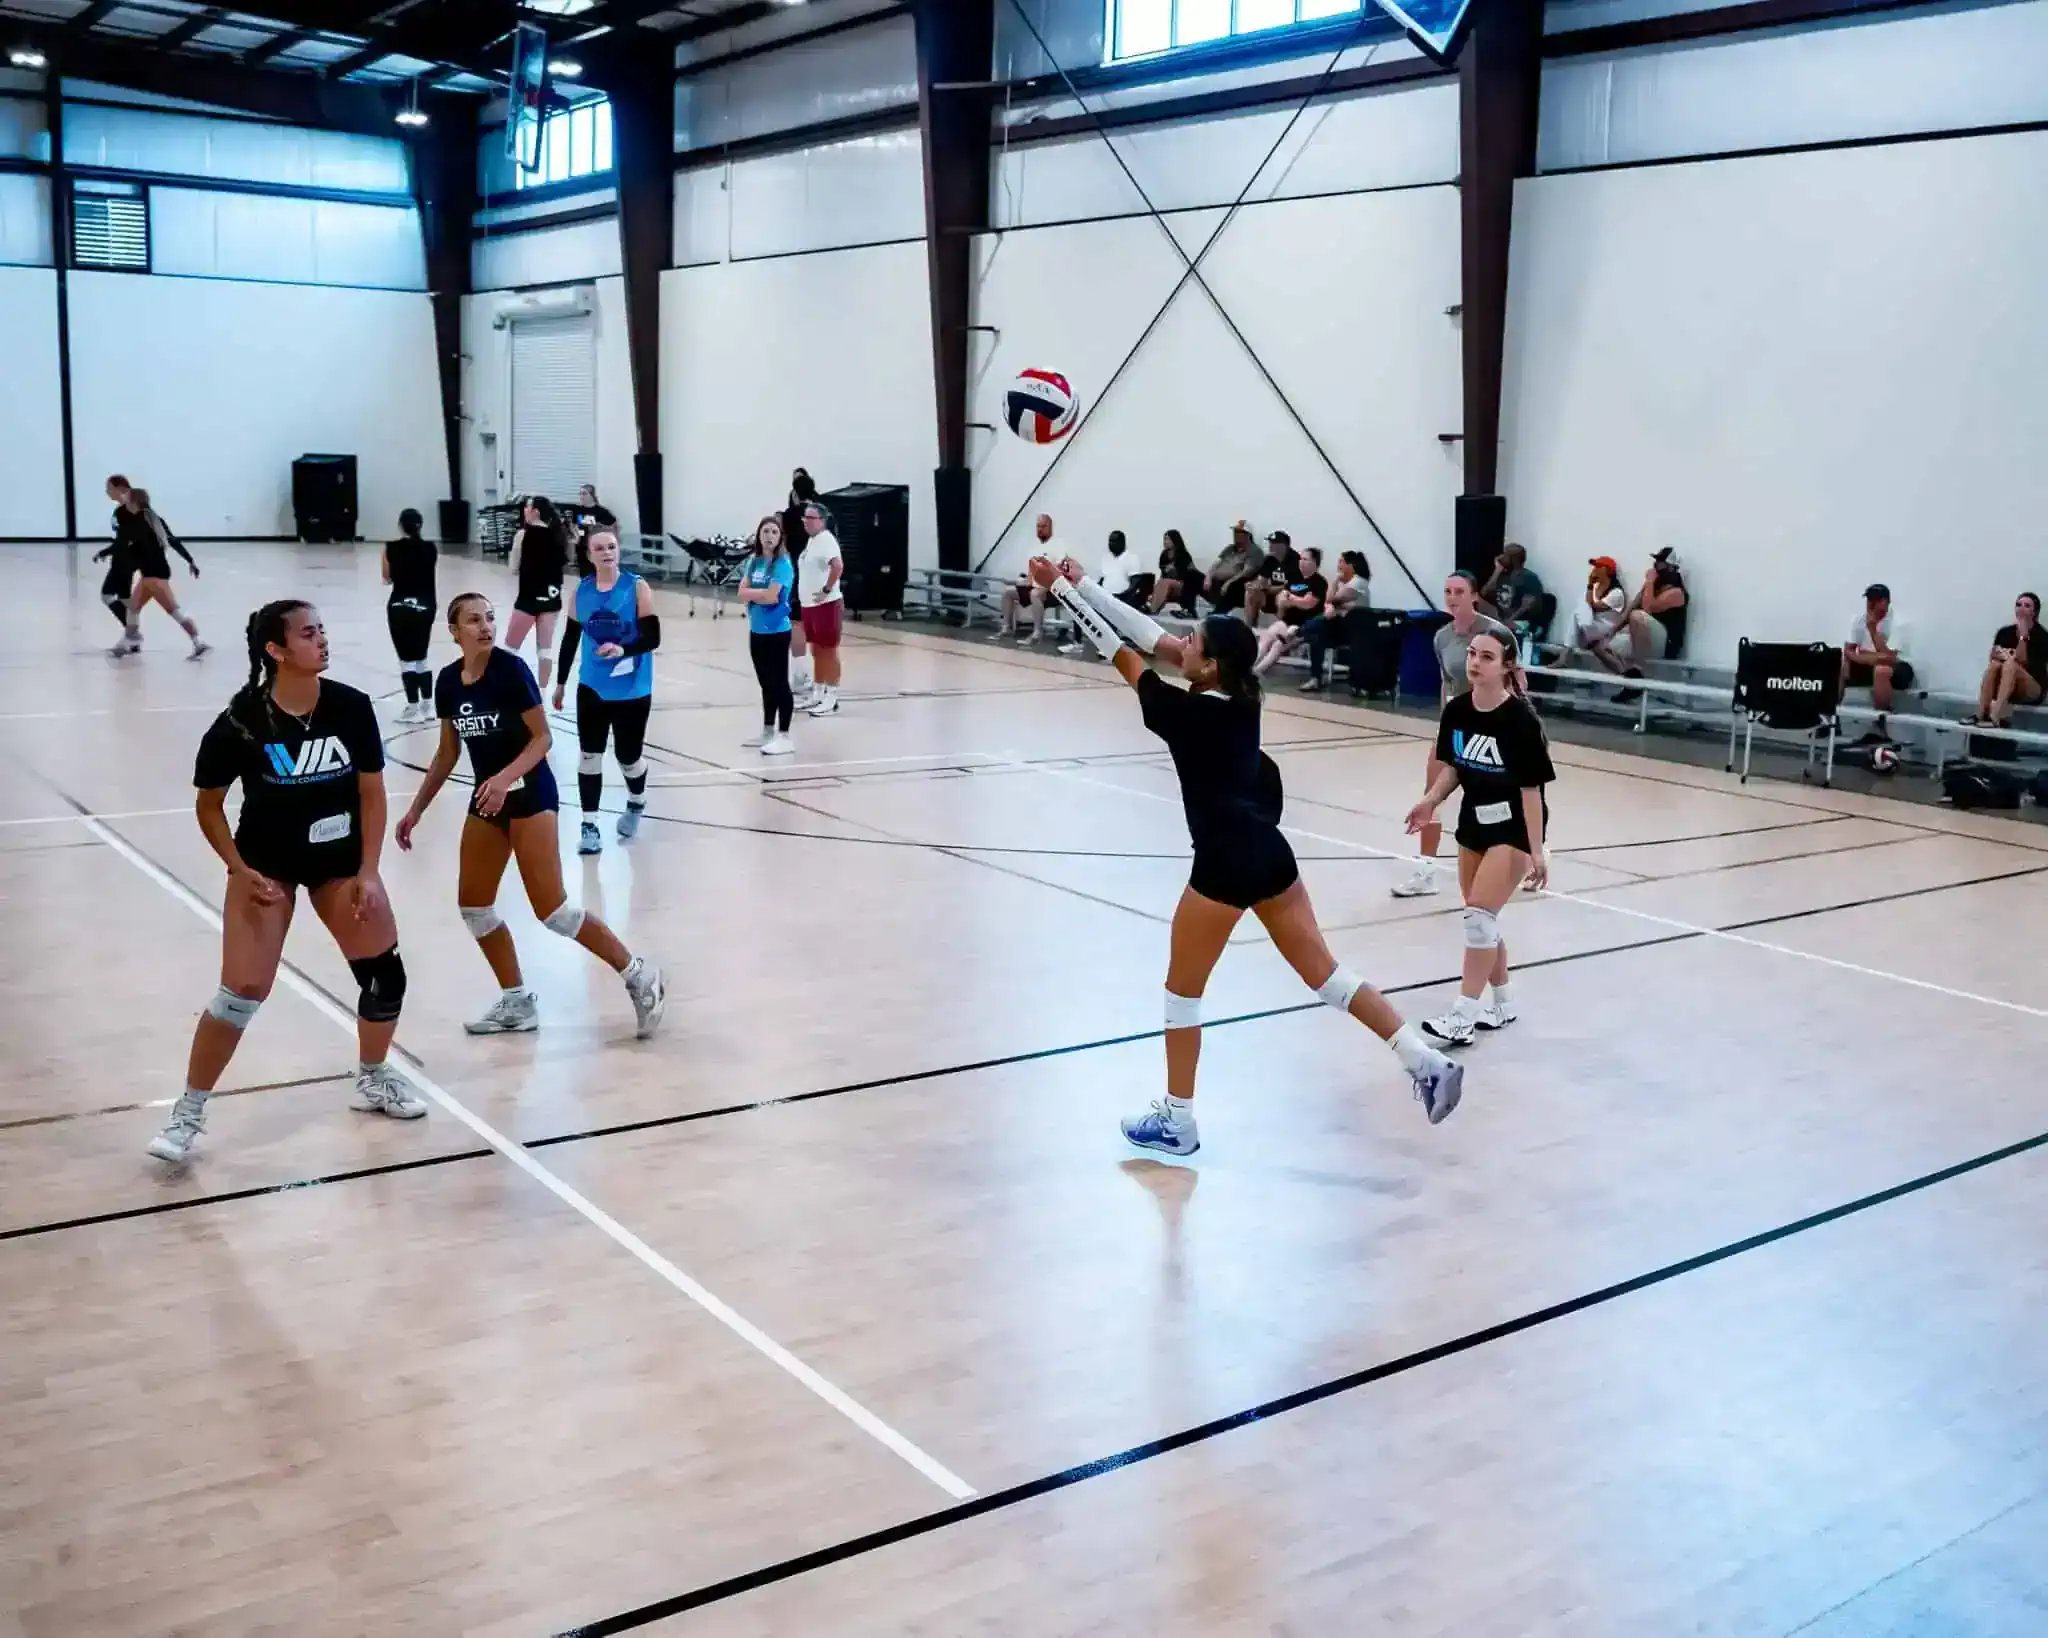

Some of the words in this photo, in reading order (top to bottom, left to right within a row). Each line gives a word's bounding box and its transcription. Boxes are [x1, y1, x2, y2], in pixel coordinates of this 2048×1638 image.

[1766, 675, 1823, 692] molten
[460, 703, 473, 715] C
[452, 713, 499, 731] ARSITY
